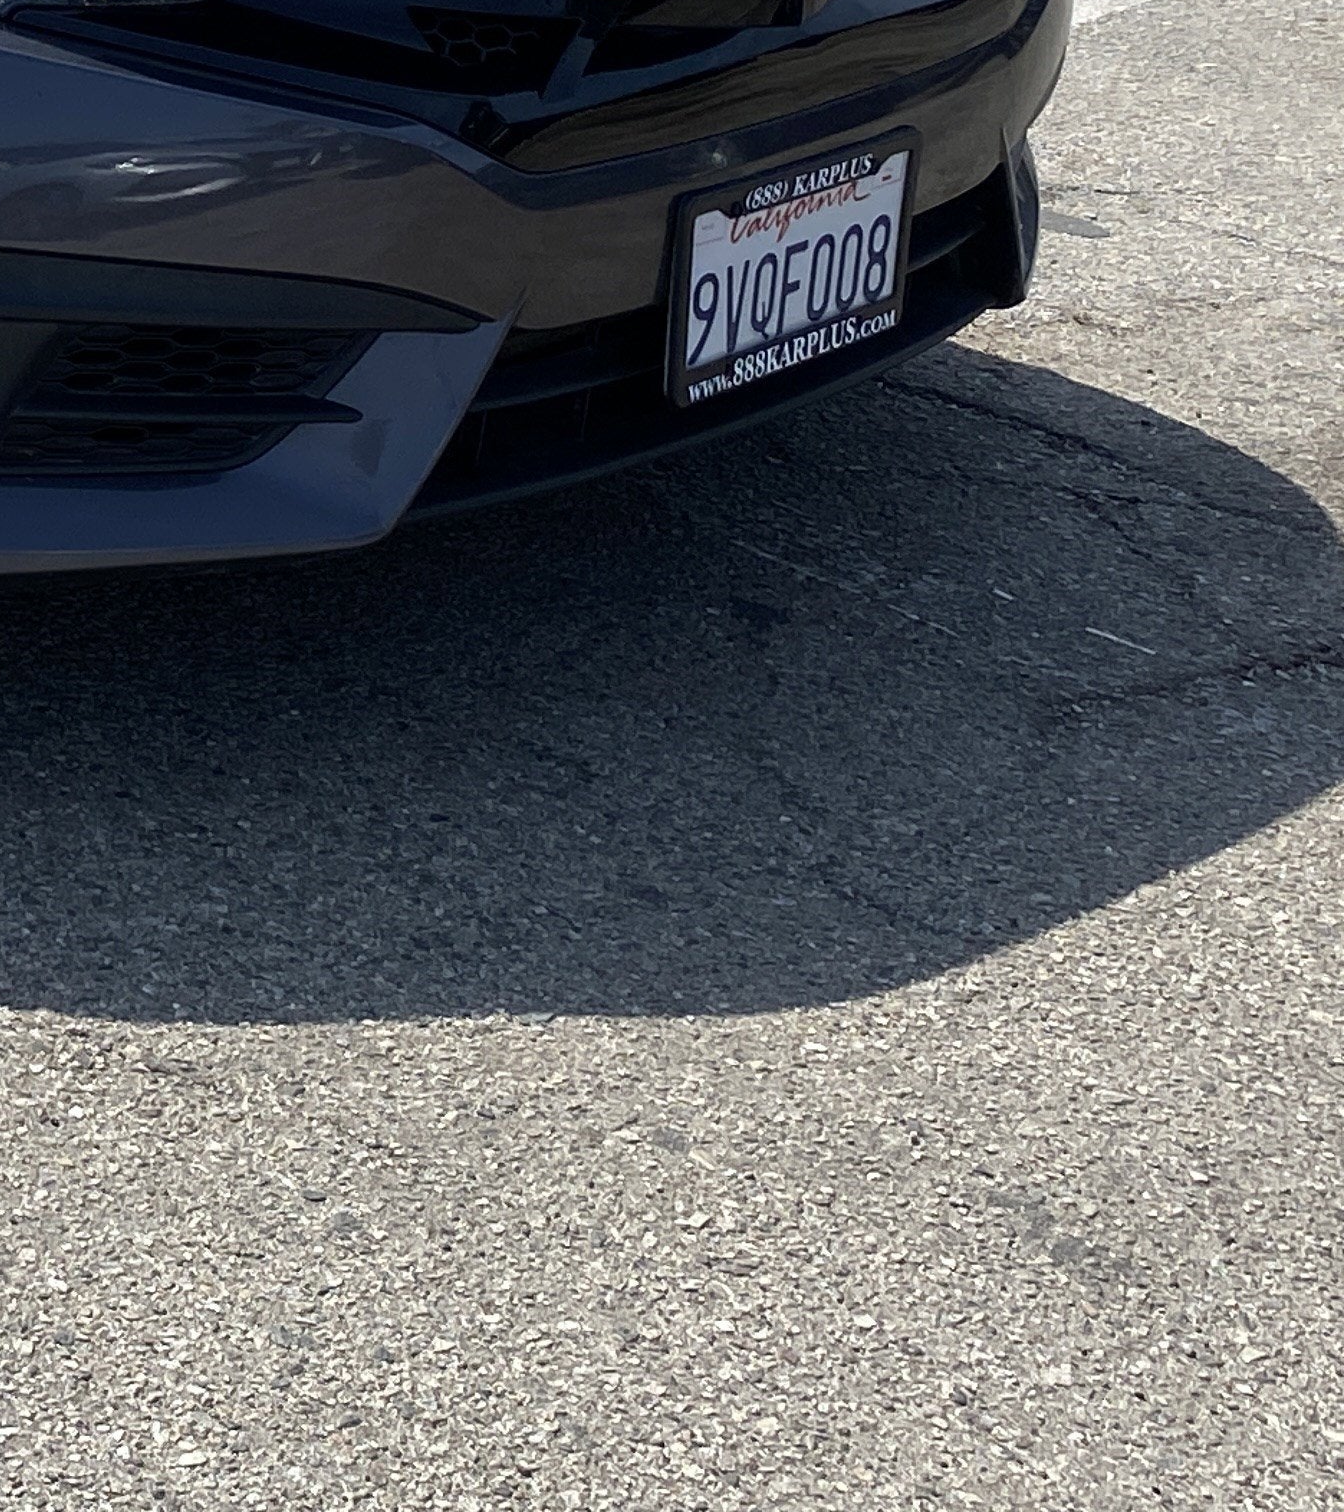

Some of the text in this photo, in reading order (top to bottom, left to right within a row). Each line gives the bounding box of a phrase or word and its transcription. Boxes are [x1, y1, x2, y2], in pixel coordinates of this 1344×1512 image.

[730, 180, 871, 244] California
[745, 153, 874, 209] (888) KARPLUS
[688, 213, 891, 366] 9VQF008
